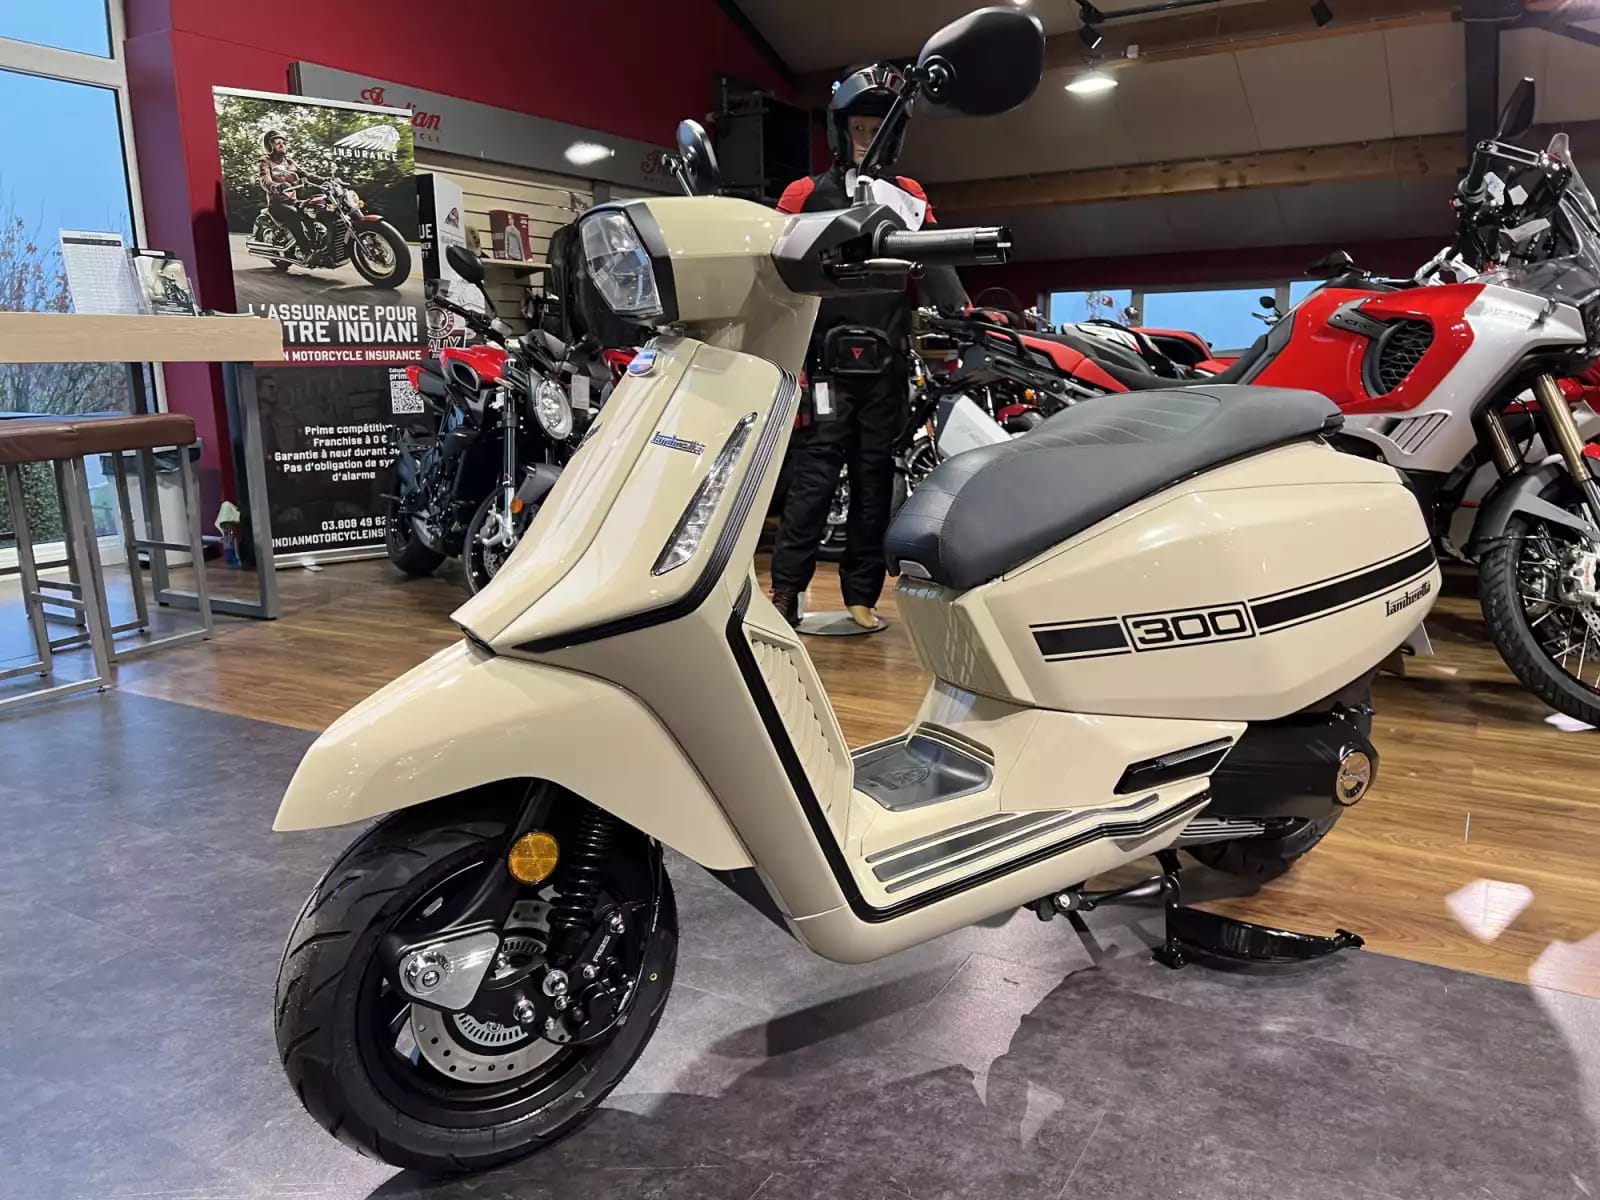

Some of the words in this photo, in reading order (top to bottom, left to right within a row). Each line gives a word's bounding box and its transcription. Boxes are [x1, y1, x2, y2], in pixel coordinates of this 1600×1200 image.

[333, 147, 398, 161] INSURANCE
[248, 303, 370, 321] L'ASSURANCE
[375, 306, 417, 322] POUR
[338, 322, 419, 343] INDIAN!
[292, 351, 362, 361] MOTORCYCLE
[365, 350, 422, 361] INSURANCE
[389, 373, 408, 381] prim
[305, 425, 335, 435] Prime
[313, 436, 362, 447] Franchise
[275, 450, 319, 461] Garantie
[330, 448, 352, 458] neuf
[354, 446, 387, 457] durant
[283, 463, 302, 473] Pas
[305, 460, 363, 472] d'obligation
[365, 459, 377, 468] de
[332, 472, 376, 482] d'alarme
[321, 519, 357, 532] 03.808
[360, 517, 373, 527] 49
[1384, 580, 1431, 617] Lambretta
[1132, 607, 1246, 644] 300
